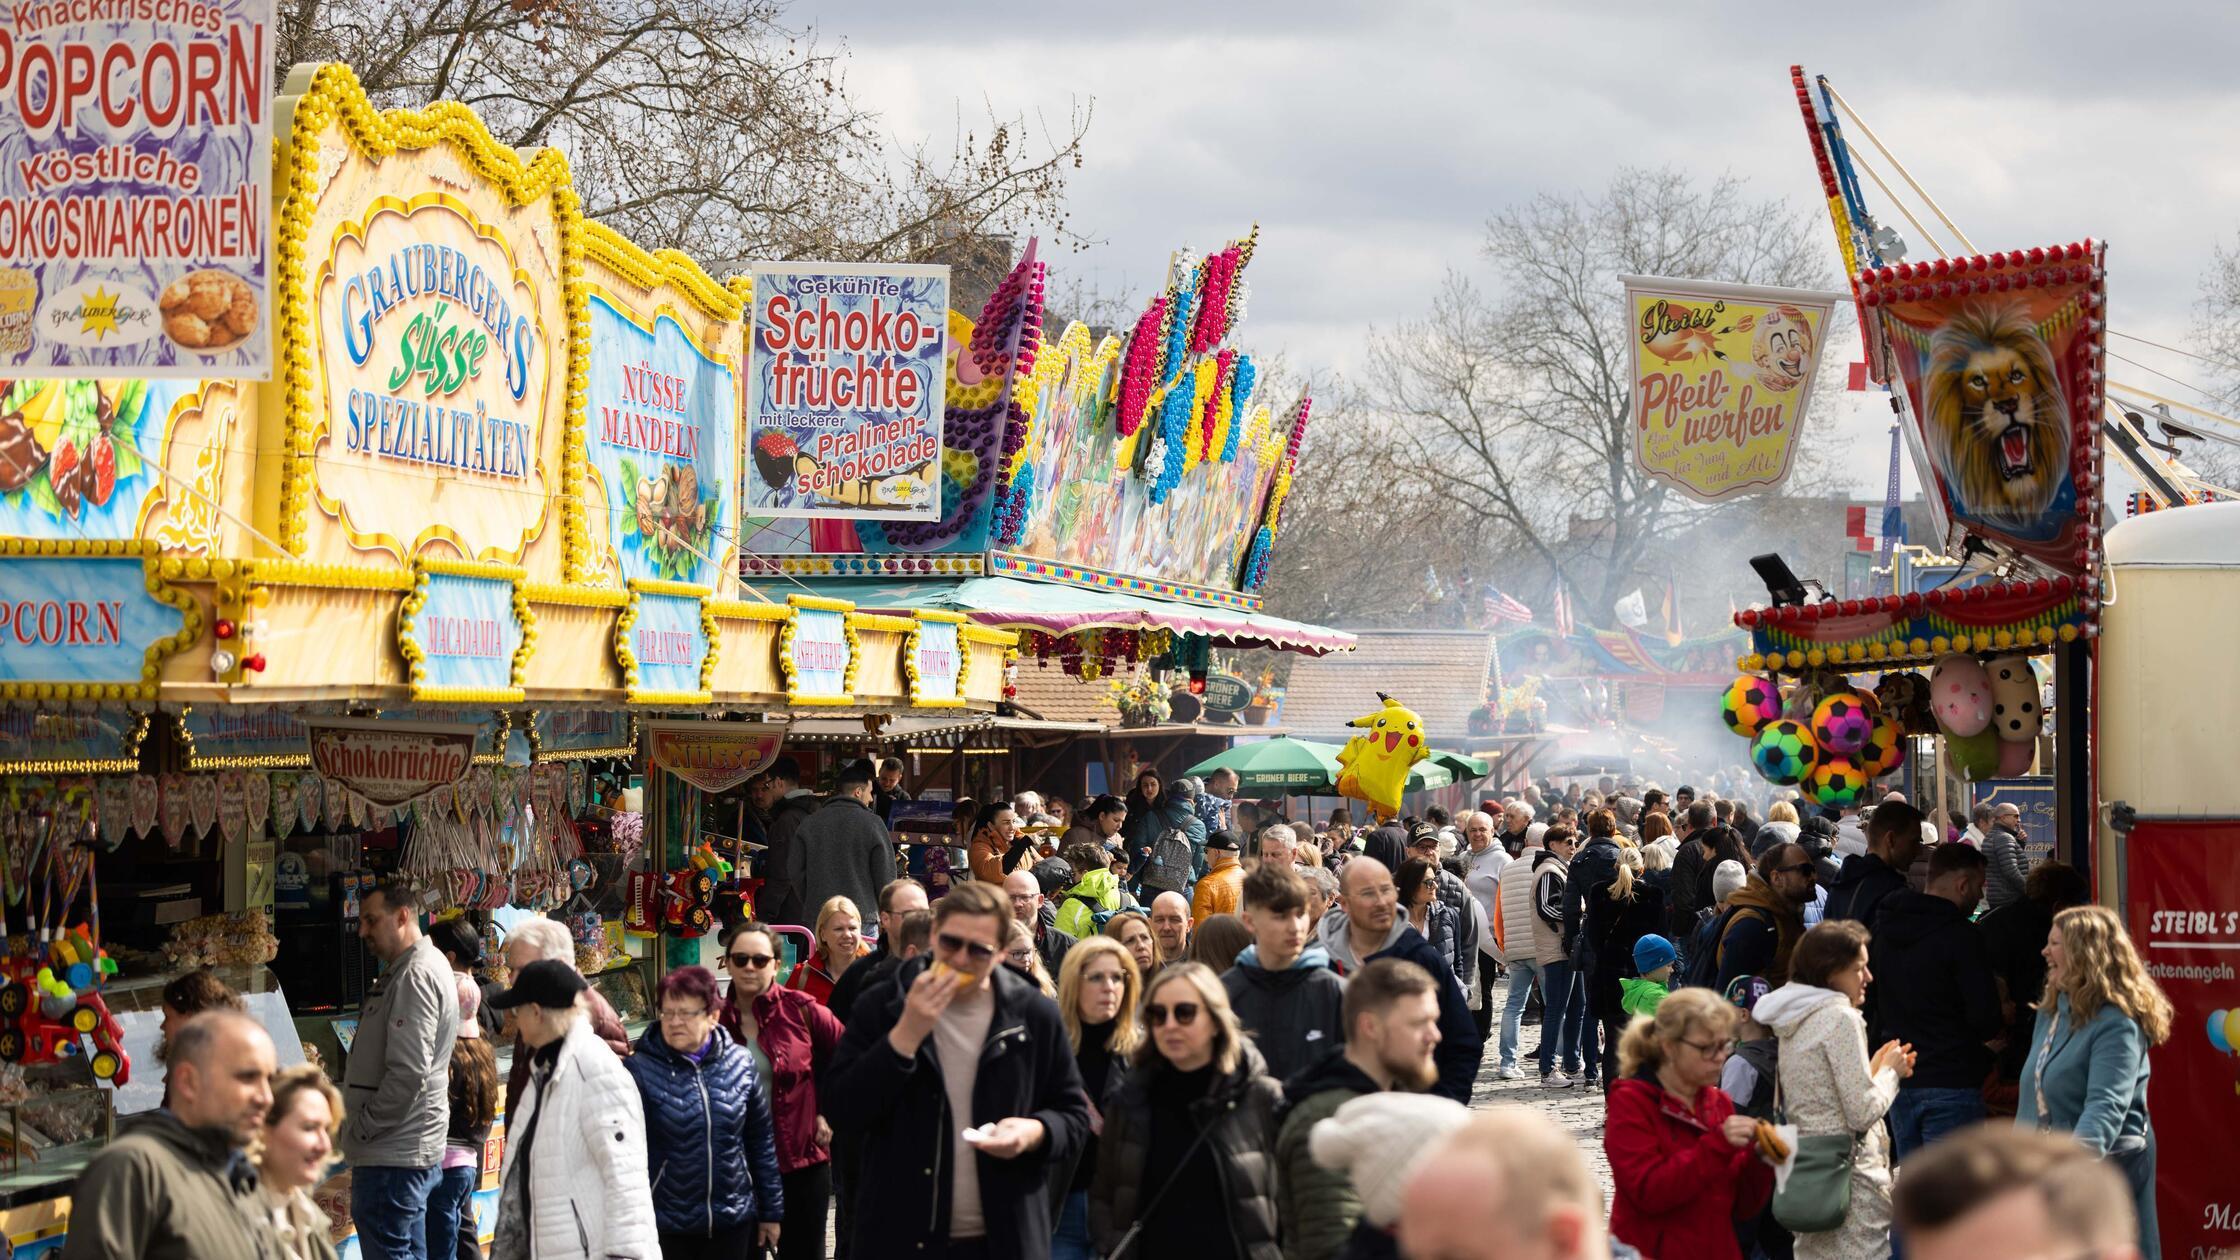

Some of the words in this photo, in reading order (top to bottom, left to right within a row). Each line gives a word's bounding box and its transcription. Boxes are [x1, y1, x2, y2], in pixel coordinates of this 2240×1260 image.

[20, 147, 198, 192] Köstliche
[796, 279, 899, 296] Gekühlte
[341, 243, 534, 401] GRAUBERGERS
[765, 296, 935, 351] Schoko-
[622, 361, 687, 413] NÜSSE
[773, 352, 916, 408] früchte
[1639, 369, 1730, 431] Pfeil-
[346, 387, 530, 478] SPEZIALITÄTEN
[601, 406, 701, 459] MANDELN
[759, 413, 784, 426] mit
[787, 412, 846, 427] leckerer
[817, 417, 926, 462] Pralinen-
[1683, 385, 1784, 448] werfen
[797, 436, 937, 495] schokolade
[427, 616, 501, 658] MACADAMIA
[1208, 693, 1233, 706] BIERE
[319, 740, 461, 783] Schokofrüchte
[1288, 773, 1309, 783] BIERE
[2143, 960, 2235, 984] Entenangeln
